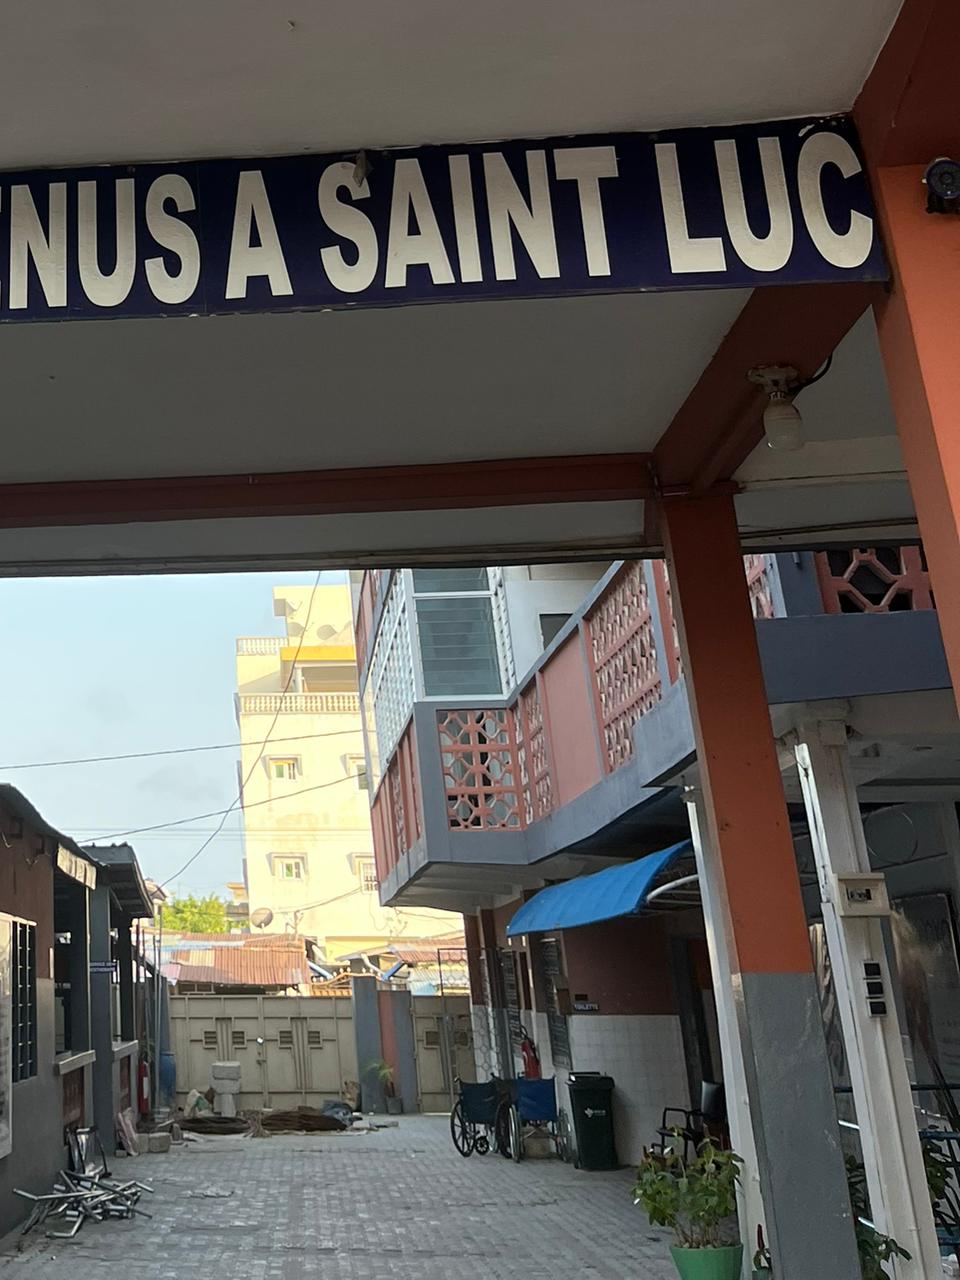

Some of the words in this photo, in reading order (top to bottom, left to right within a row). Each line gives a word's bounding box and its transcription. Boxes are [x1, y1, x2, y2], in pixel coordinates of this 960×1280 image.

[225, 169, 293, 300] A
[318, 145, 619, 294] SAINT
[655, 131, 873, 274] LUC
